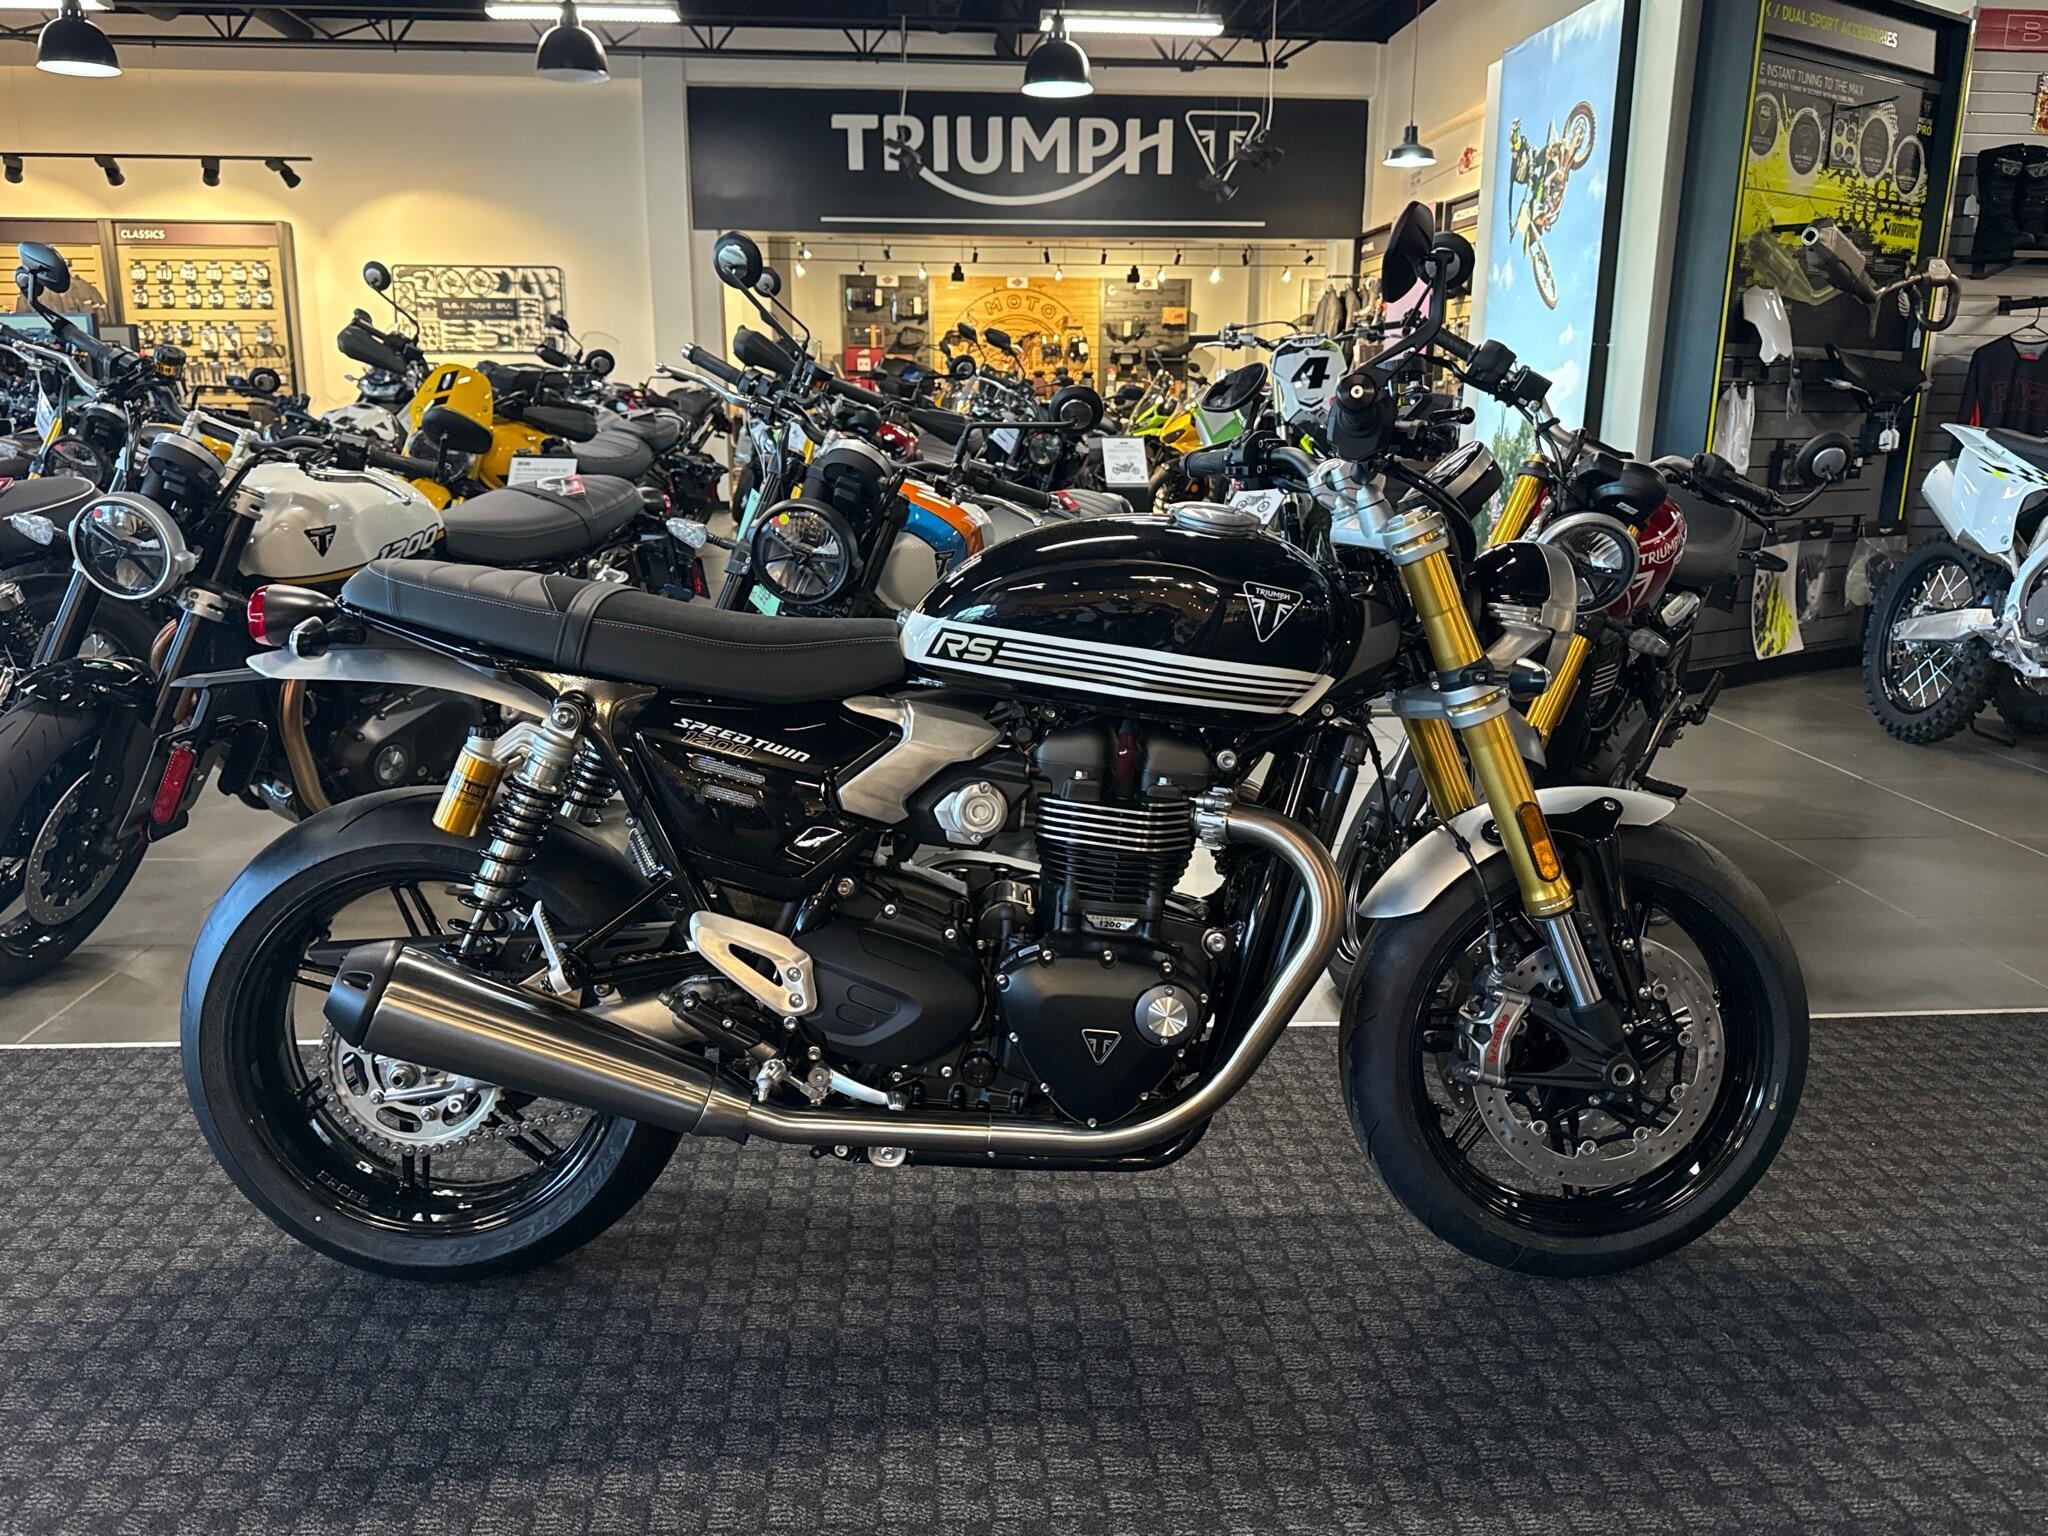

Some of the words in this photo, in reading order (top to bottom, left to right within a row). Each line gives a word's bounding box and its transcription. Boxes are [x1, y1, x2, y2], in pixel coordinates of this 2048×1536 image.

[1782, 5, 1807, 25] DUAL
[1811, 13, 1840, 33] SPORT
[1766, 63, 1796, 81] INSTANT
[1798, 70, 1823, 88] TUNING
[1824, 77, 1834, 90] TO
[1835, 80, 1848, 94] THE
[1916, 123, 1932, 137] PRO
[831, 114, 1174, 205] TRIUMPH
[120, 229, 166, 240] CLASSICS
[1290, 357, 1331, 390] 4
[376, 522, 441, 560] 1200
[1255, 587, 1291, 601] TRIUMPH
[932, 631, 999, 662] RS
[673, 717, 753, 744] SPEED
[752, 738, 811, 763] TWIN
[680, 730, 754, 759] 1200
